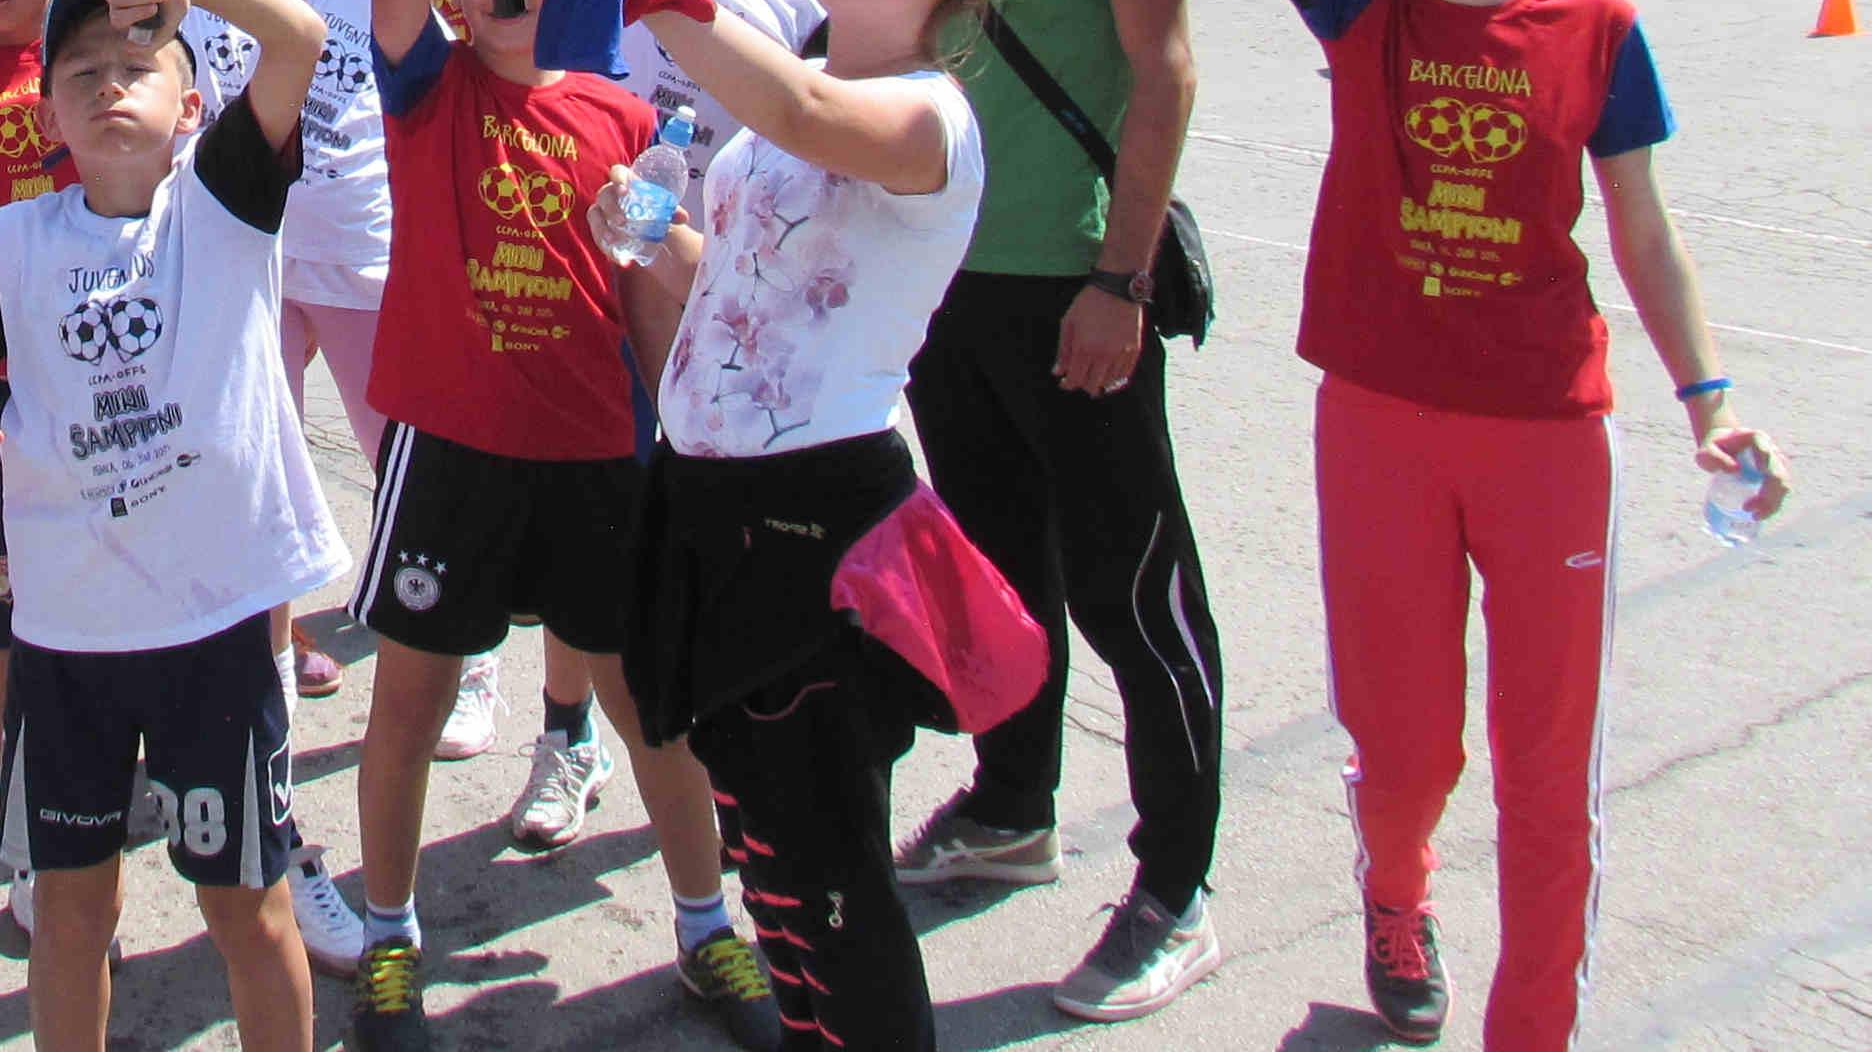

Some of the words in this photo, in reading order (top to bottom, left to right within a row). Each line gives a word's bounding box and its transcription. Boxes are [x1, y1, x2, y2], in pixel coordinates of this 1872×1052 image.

[324, 12, 372, 49] JUVENT
[1409, 59, 1531, 97] BARCELONA
[483, 115, 579, 161] BARCELONA
[69, 251, 156, 293] JUVENUS
[492, 241, 545, 271] MINI
[93, 385, 149, 422] MINI
[69, 402, 184, 460] ŠAMPIONI
[39, 807, 122, 826] GIVOVA
